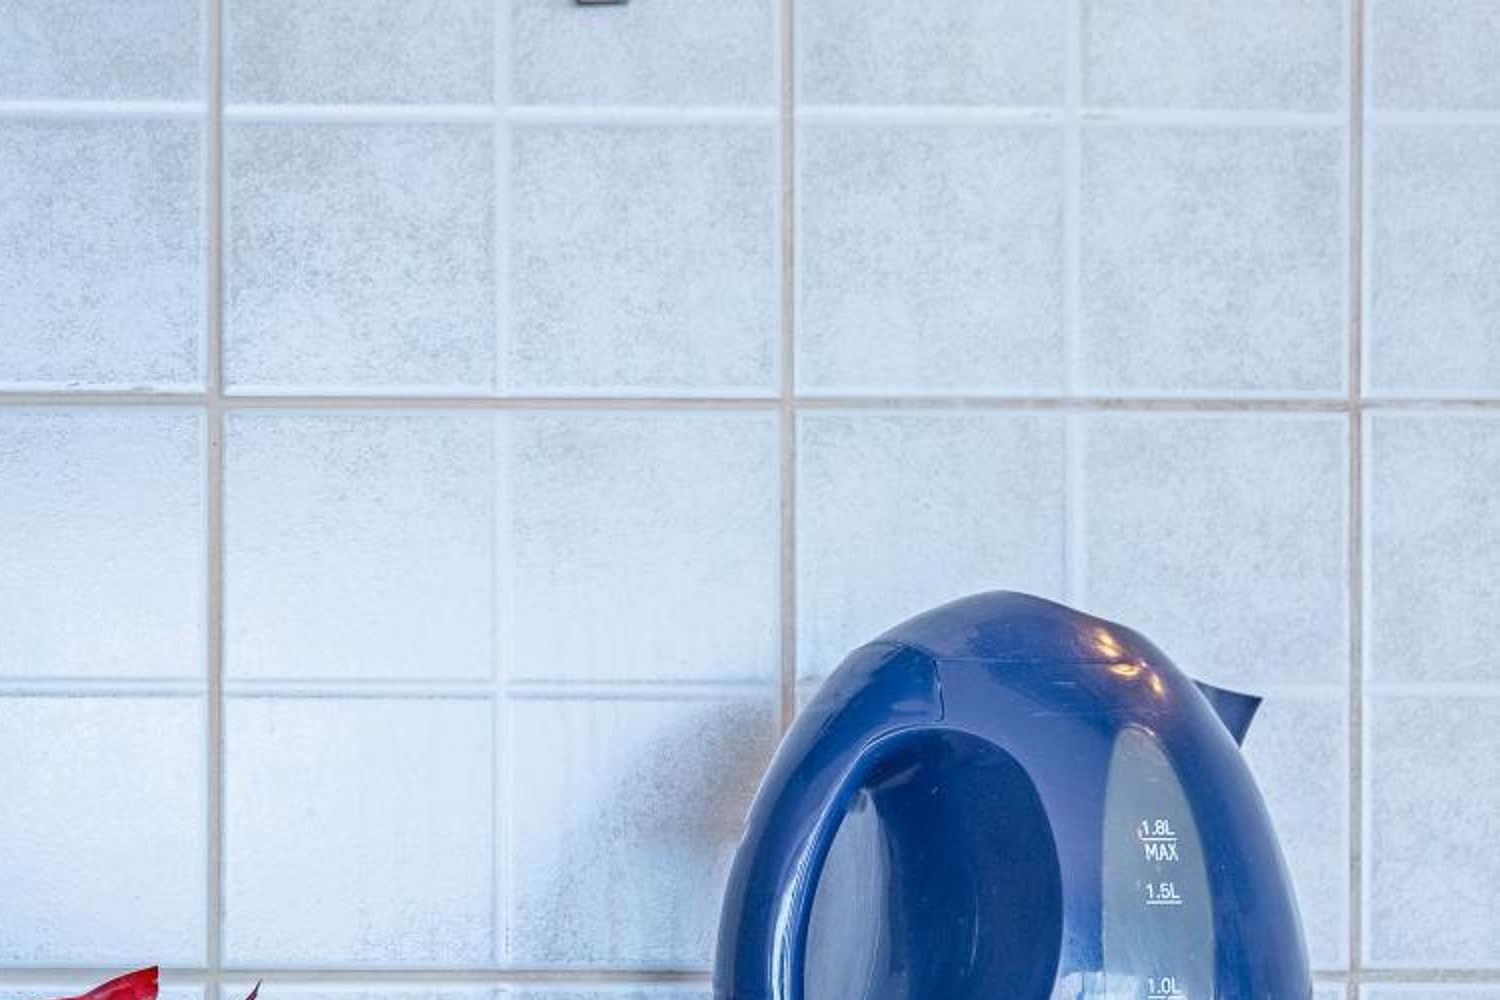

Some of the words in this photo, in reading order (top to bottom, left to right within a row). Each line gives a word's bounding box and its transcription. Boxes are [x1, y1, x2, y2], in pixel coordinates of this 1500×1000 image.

[1141, 820, 1175, 836] 1.8L
[1145, 843, 1178, 861] MAX
[1146, 884, 1180, 899] 1.5L
[1147, 978, 1181, 995] 1.0L
